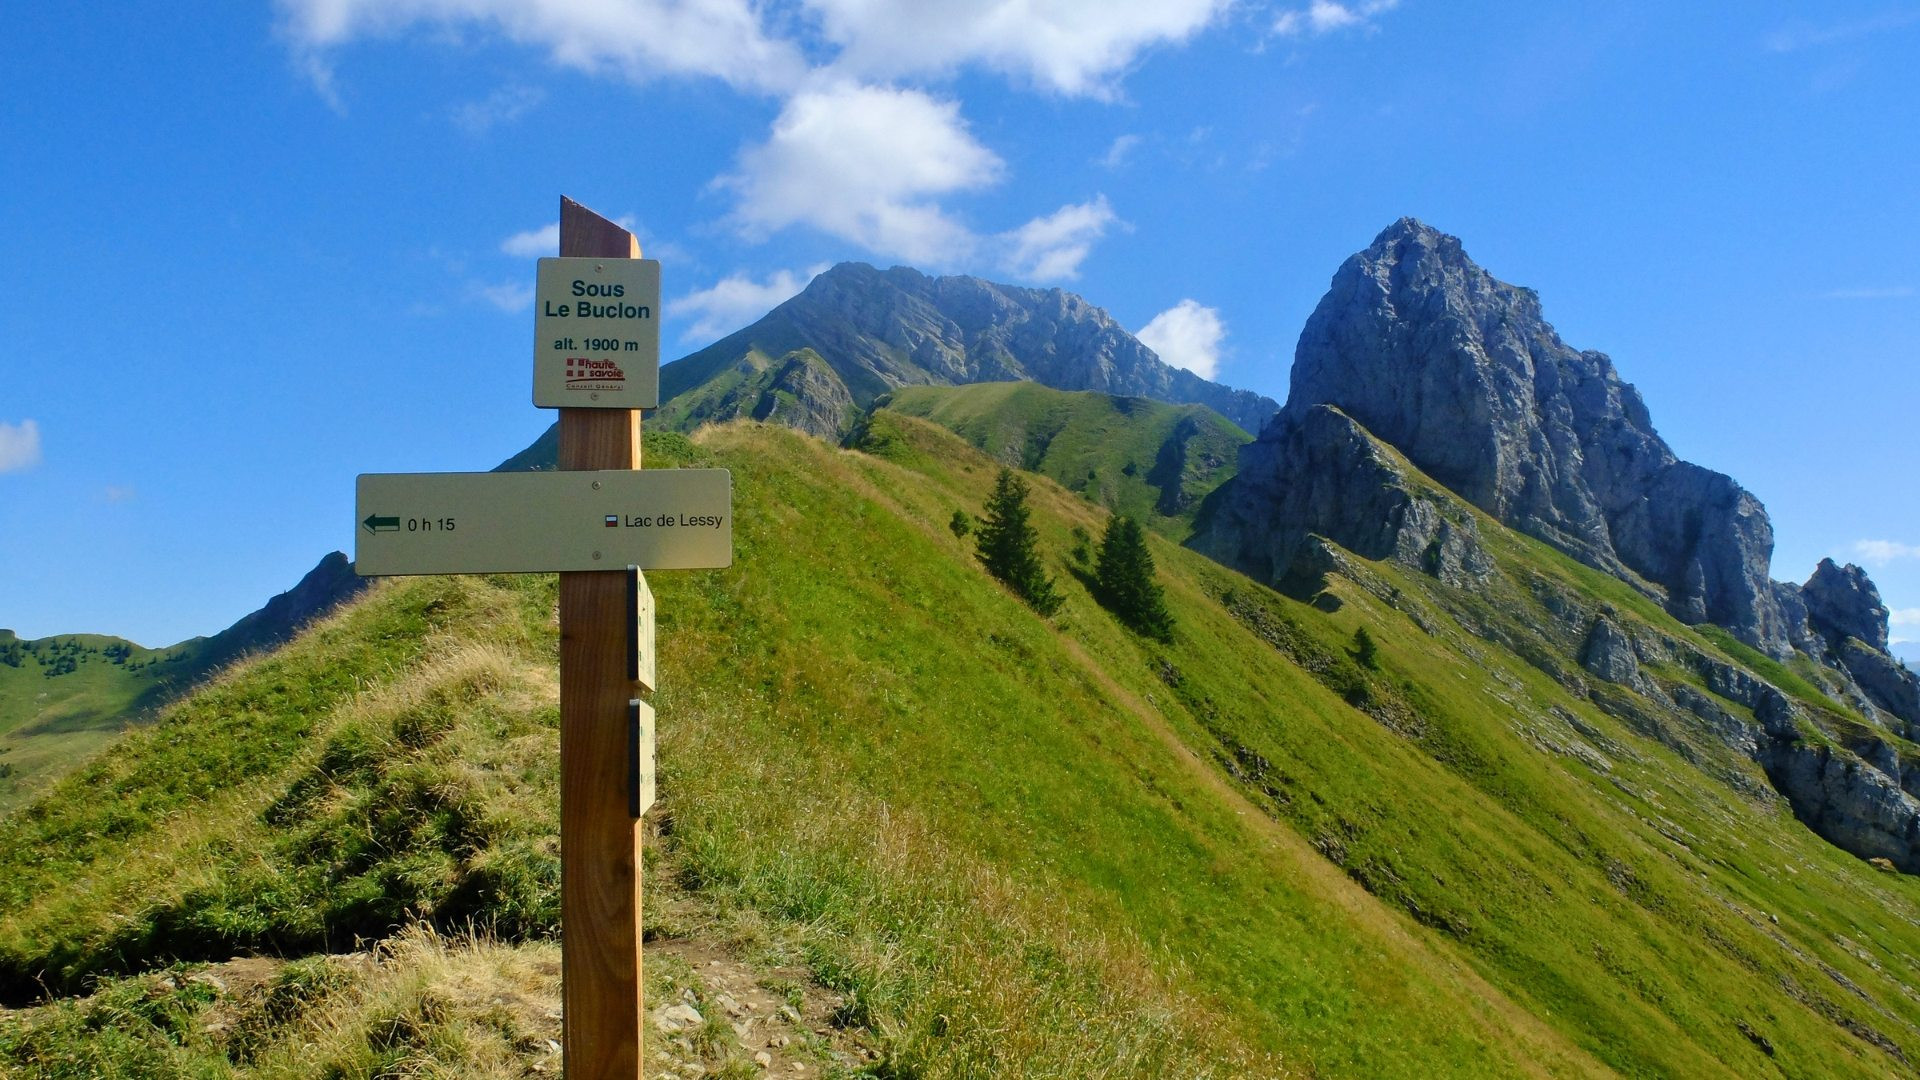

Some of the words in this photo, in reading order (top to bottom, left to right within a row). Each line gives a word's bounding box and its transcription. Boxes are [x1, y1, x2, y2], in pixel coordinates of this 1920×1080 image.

[572, 280, 625, 297] Sous
[545, 301, 570, 317] Le
[577, 301, 650, 319] Buclon
[554, 337, 578, 350] alt.
[584, 338, 619, 351] 1900
[624, 340, 638, 351] m
[589, 369, 624, 378] savoie
[408, 518, 417, 531] 0
[422, 517, 431, 531] h
[437, 518, 456, 531] 15
[625, 514, 652, 528] Lac
[656, 513, 675, 527] de
[680, 513, 723, 529] Lessy
